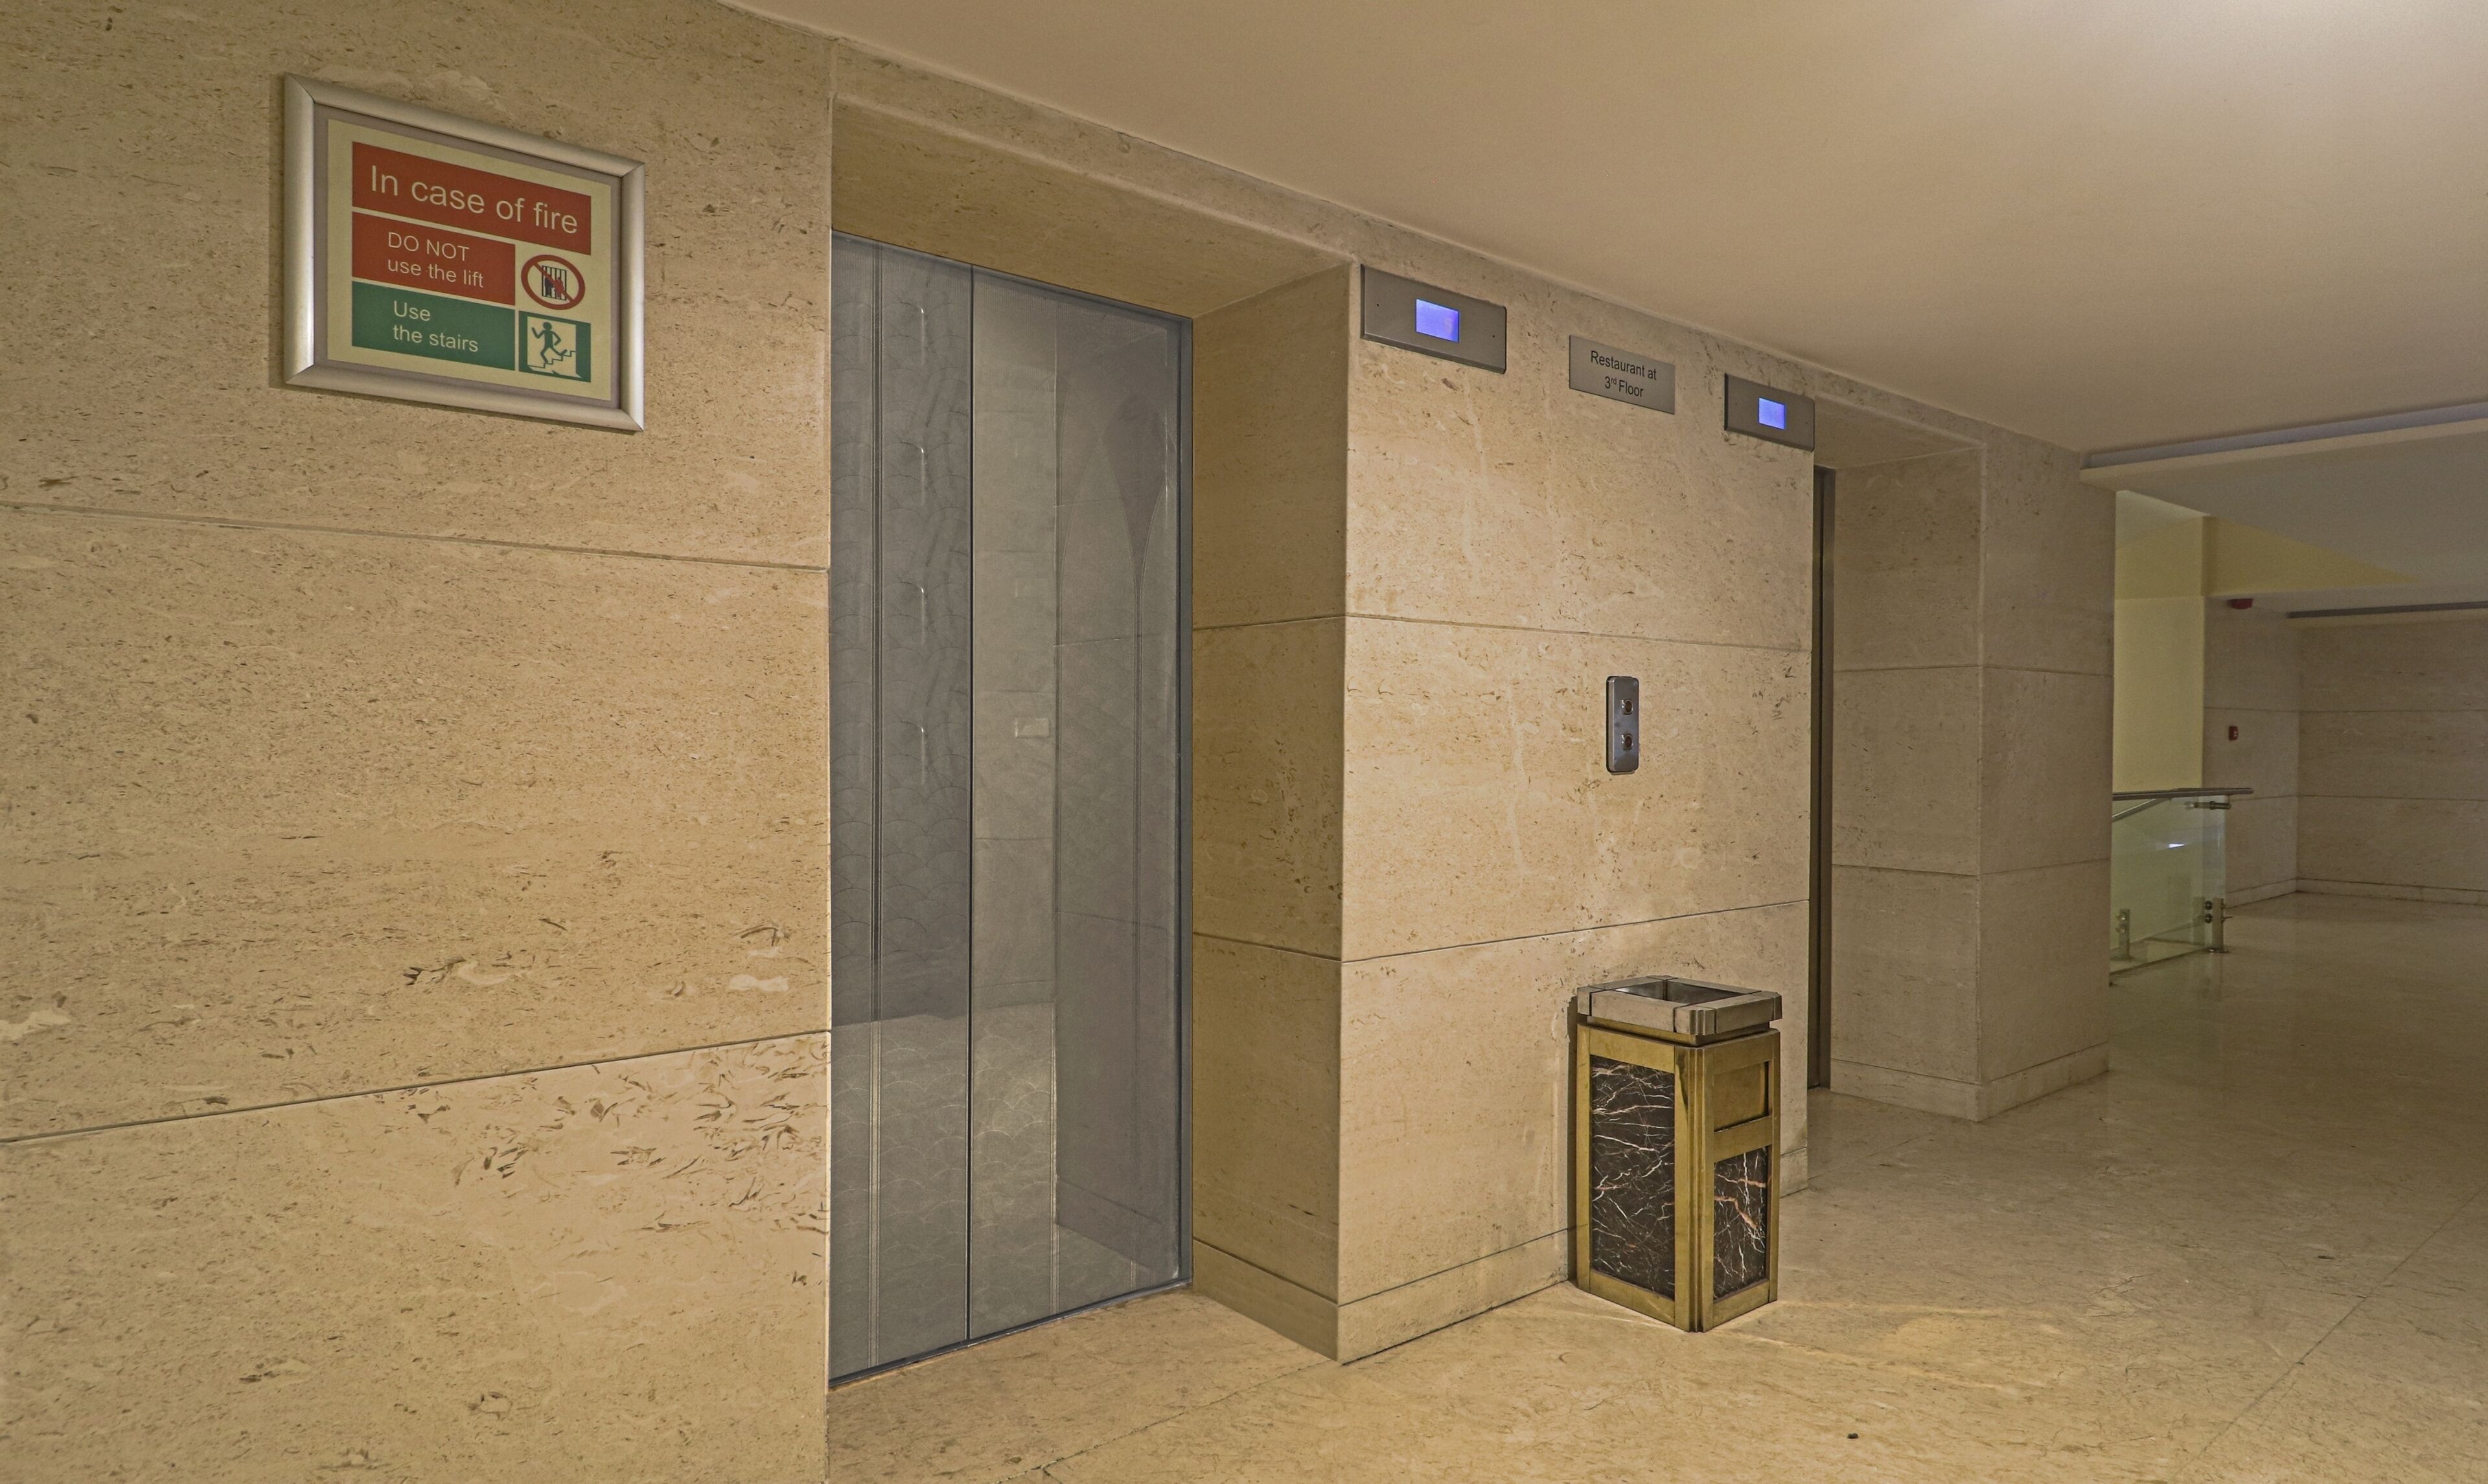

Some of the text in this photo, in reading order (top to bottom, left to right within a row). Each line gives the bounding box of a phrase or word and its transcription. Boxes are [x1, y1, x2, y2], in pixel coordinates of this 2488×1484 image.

[371, 165, 578, 234] In case of fire
[387, 231, 470, 262] DO NOT
[387, 259, 484, 288] use the lift
[393, 300, 432, 322] Use
[392, 324, 479, 353] the stairs
[1590, 350, 1657, 381] Restaurant at
[1618, 379, 1644, 398] Floor
